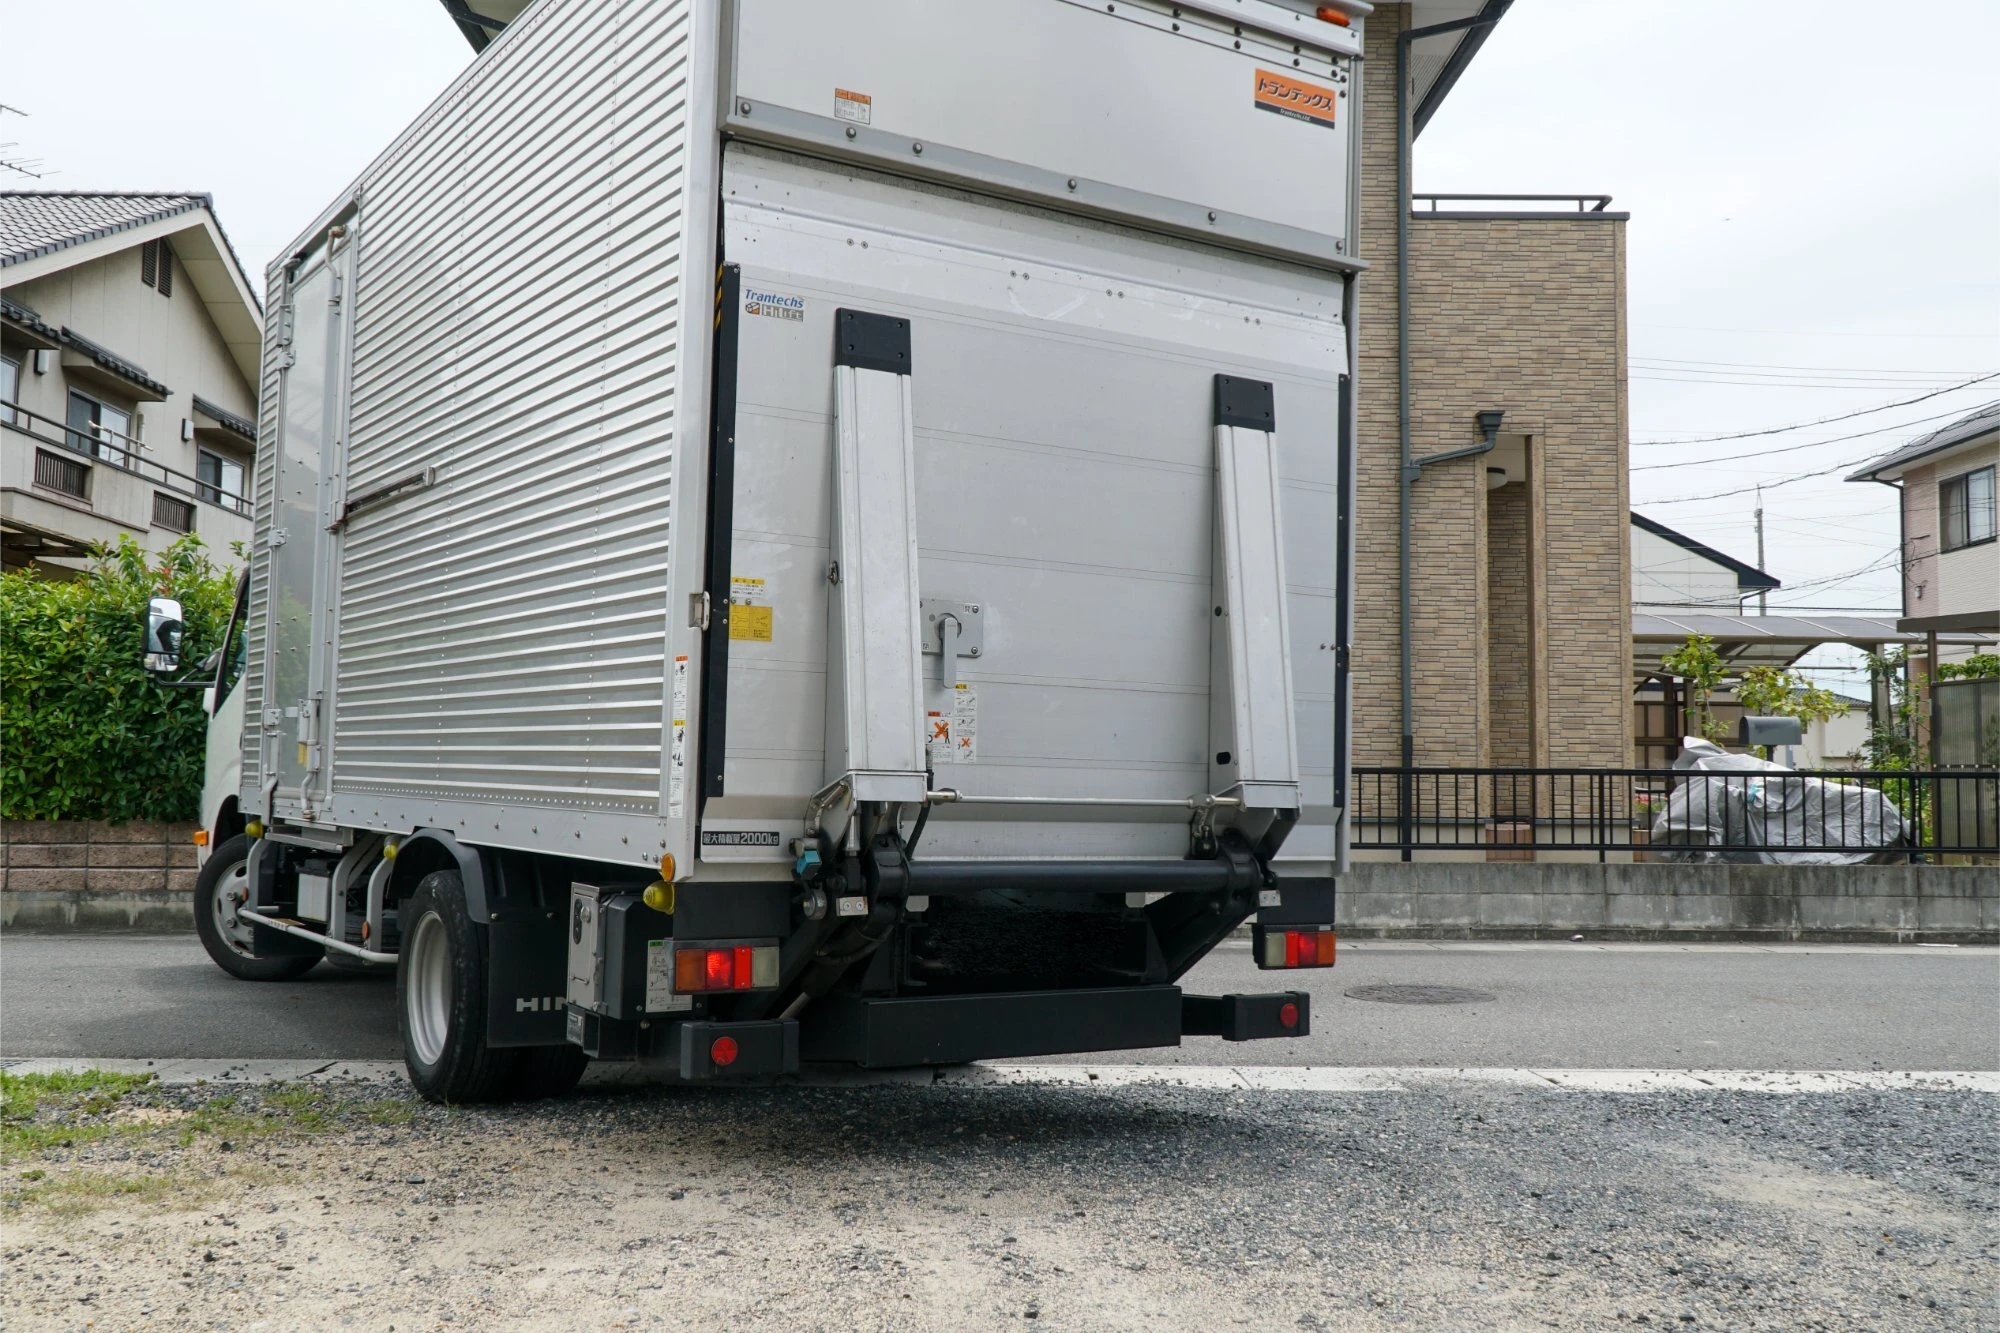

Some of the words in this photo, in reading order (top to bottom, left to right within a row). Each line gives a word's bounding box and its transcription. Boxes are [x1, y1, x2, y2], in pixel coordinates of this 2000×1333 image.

[1258, 77, 1333, 112] トランテックス
[745, 288, 804, 309] Trantechs
[703, 832, 779, 845] 最大積載量2000kg
